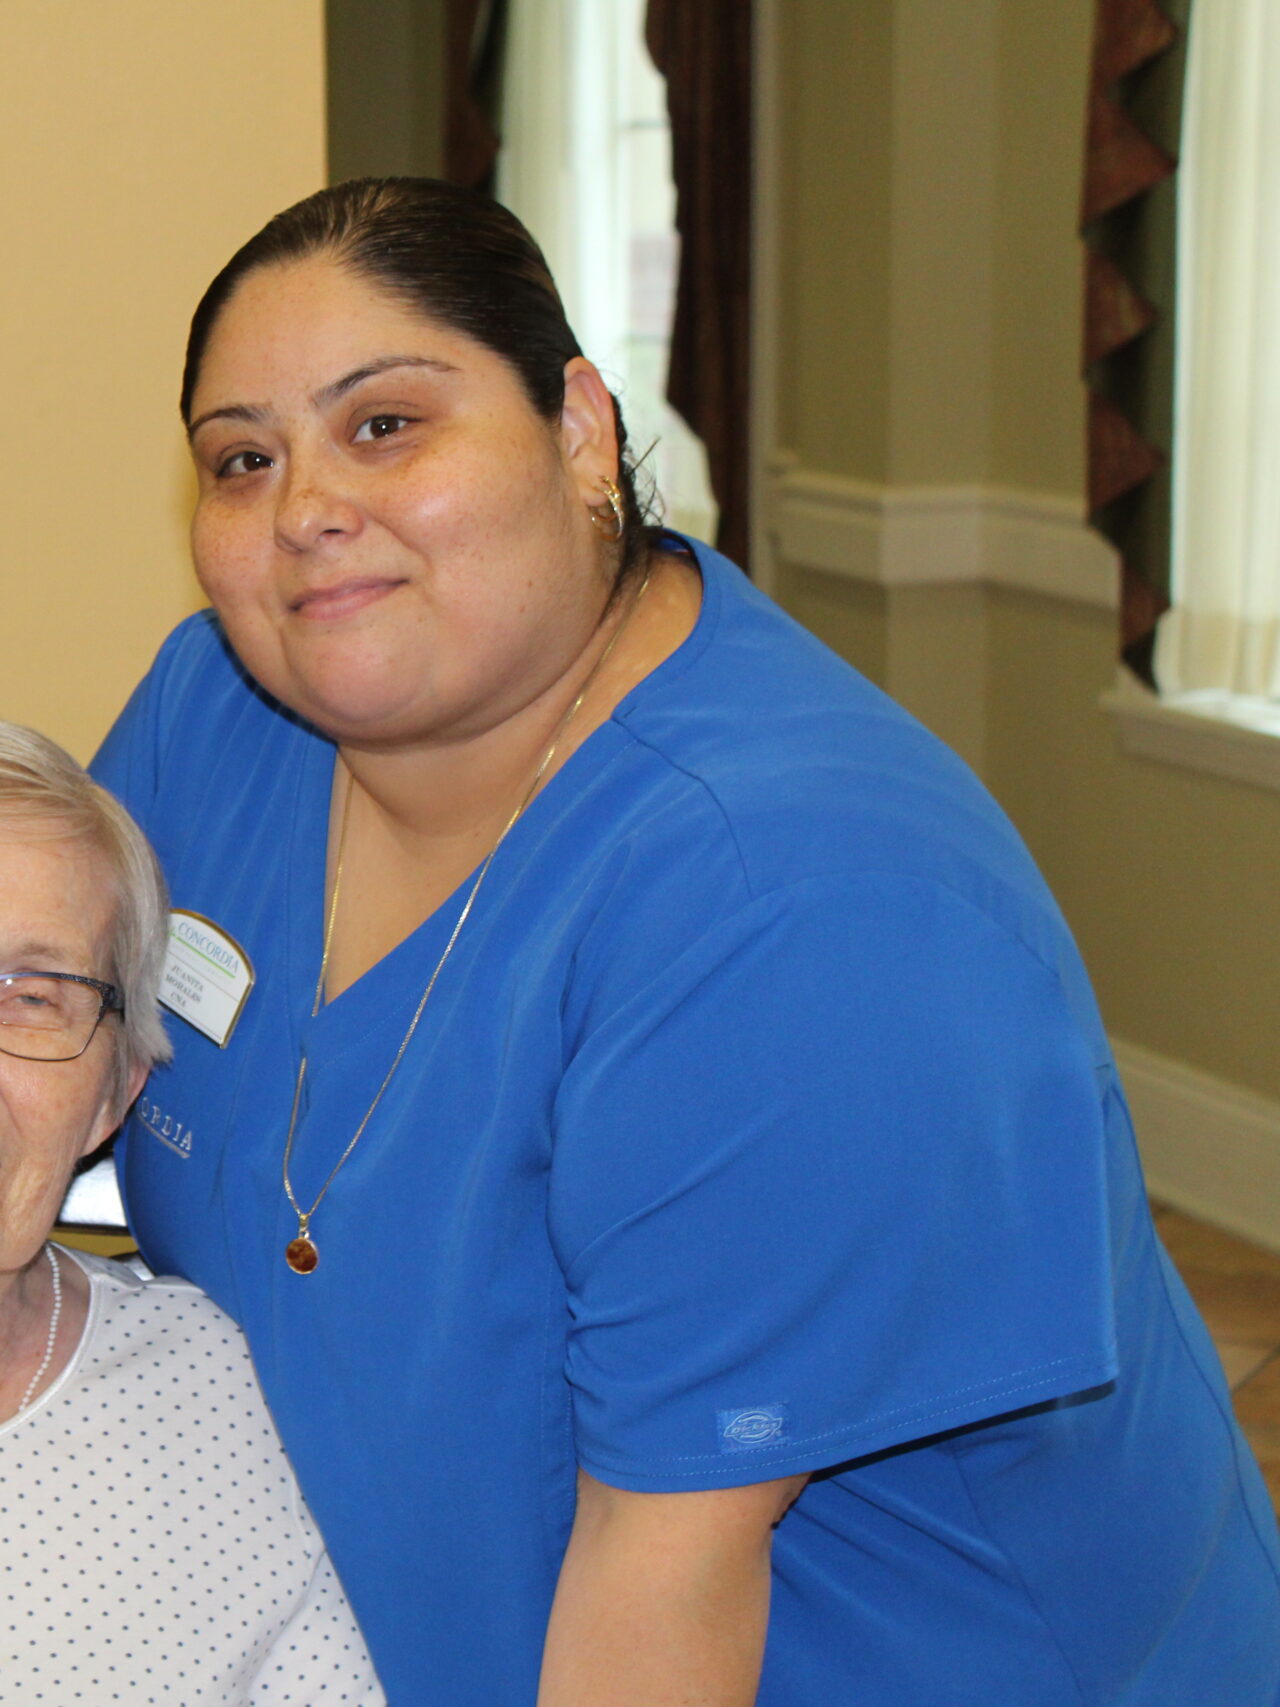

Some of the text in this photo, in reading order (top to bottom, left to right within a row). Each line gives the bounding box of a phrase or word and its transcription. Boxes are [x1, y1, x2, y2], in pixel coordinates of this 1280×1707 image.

[178, 922, 239, 974] CONCORDIA
[166, 974, 201, 1003] MORALES
[171, 965, 203, 993] JUANITA
[170, 991, 187, 1007] CNA
[140, 1096, 192, 1151] ORDIA
